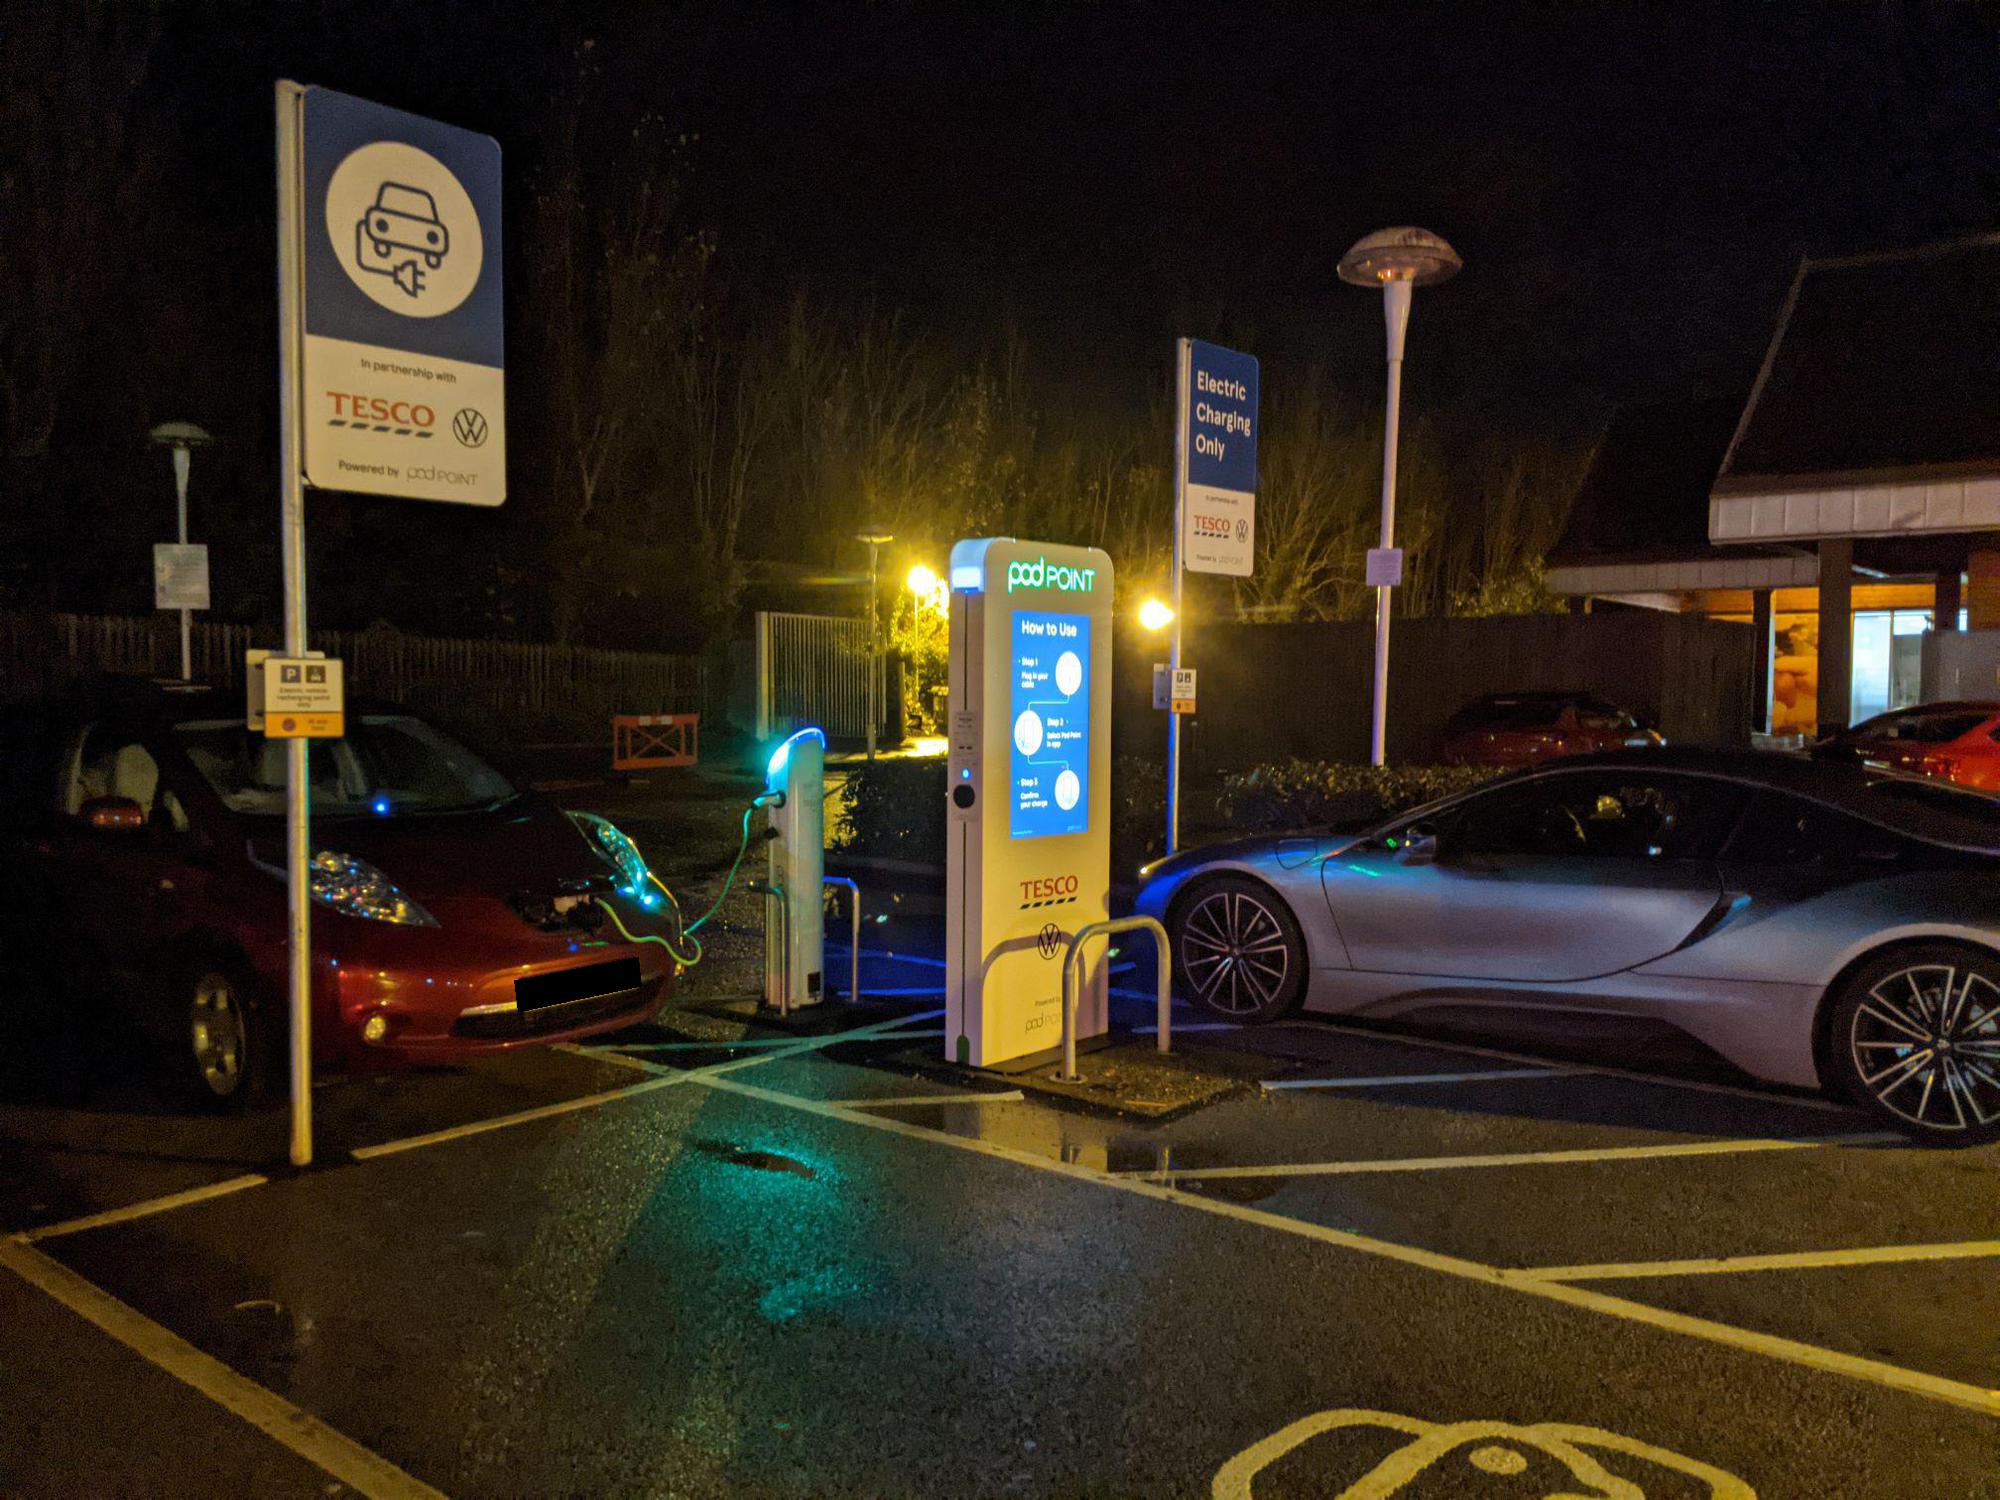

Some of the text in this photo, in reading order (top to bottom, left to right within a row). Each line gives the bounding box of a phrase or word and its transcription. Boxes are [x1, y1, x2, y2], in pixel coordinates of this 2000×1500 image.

[361, 358, 457, 384] In partnership with
[1196, 369, 1247, 401] Electric
[326, 391, 435, 427] TESCO
[1195, 402, 1251, 437] Charging
[1195, 434, 1225, 463] Only
[338, 459, 385, 476] Powered
[387, 465, 399, 479] by
[1193, 514, 1231, 533] TESCO
[1021, 619, 1077, 638] How to Use
[1020, 875, 1079, 900] TESCO
